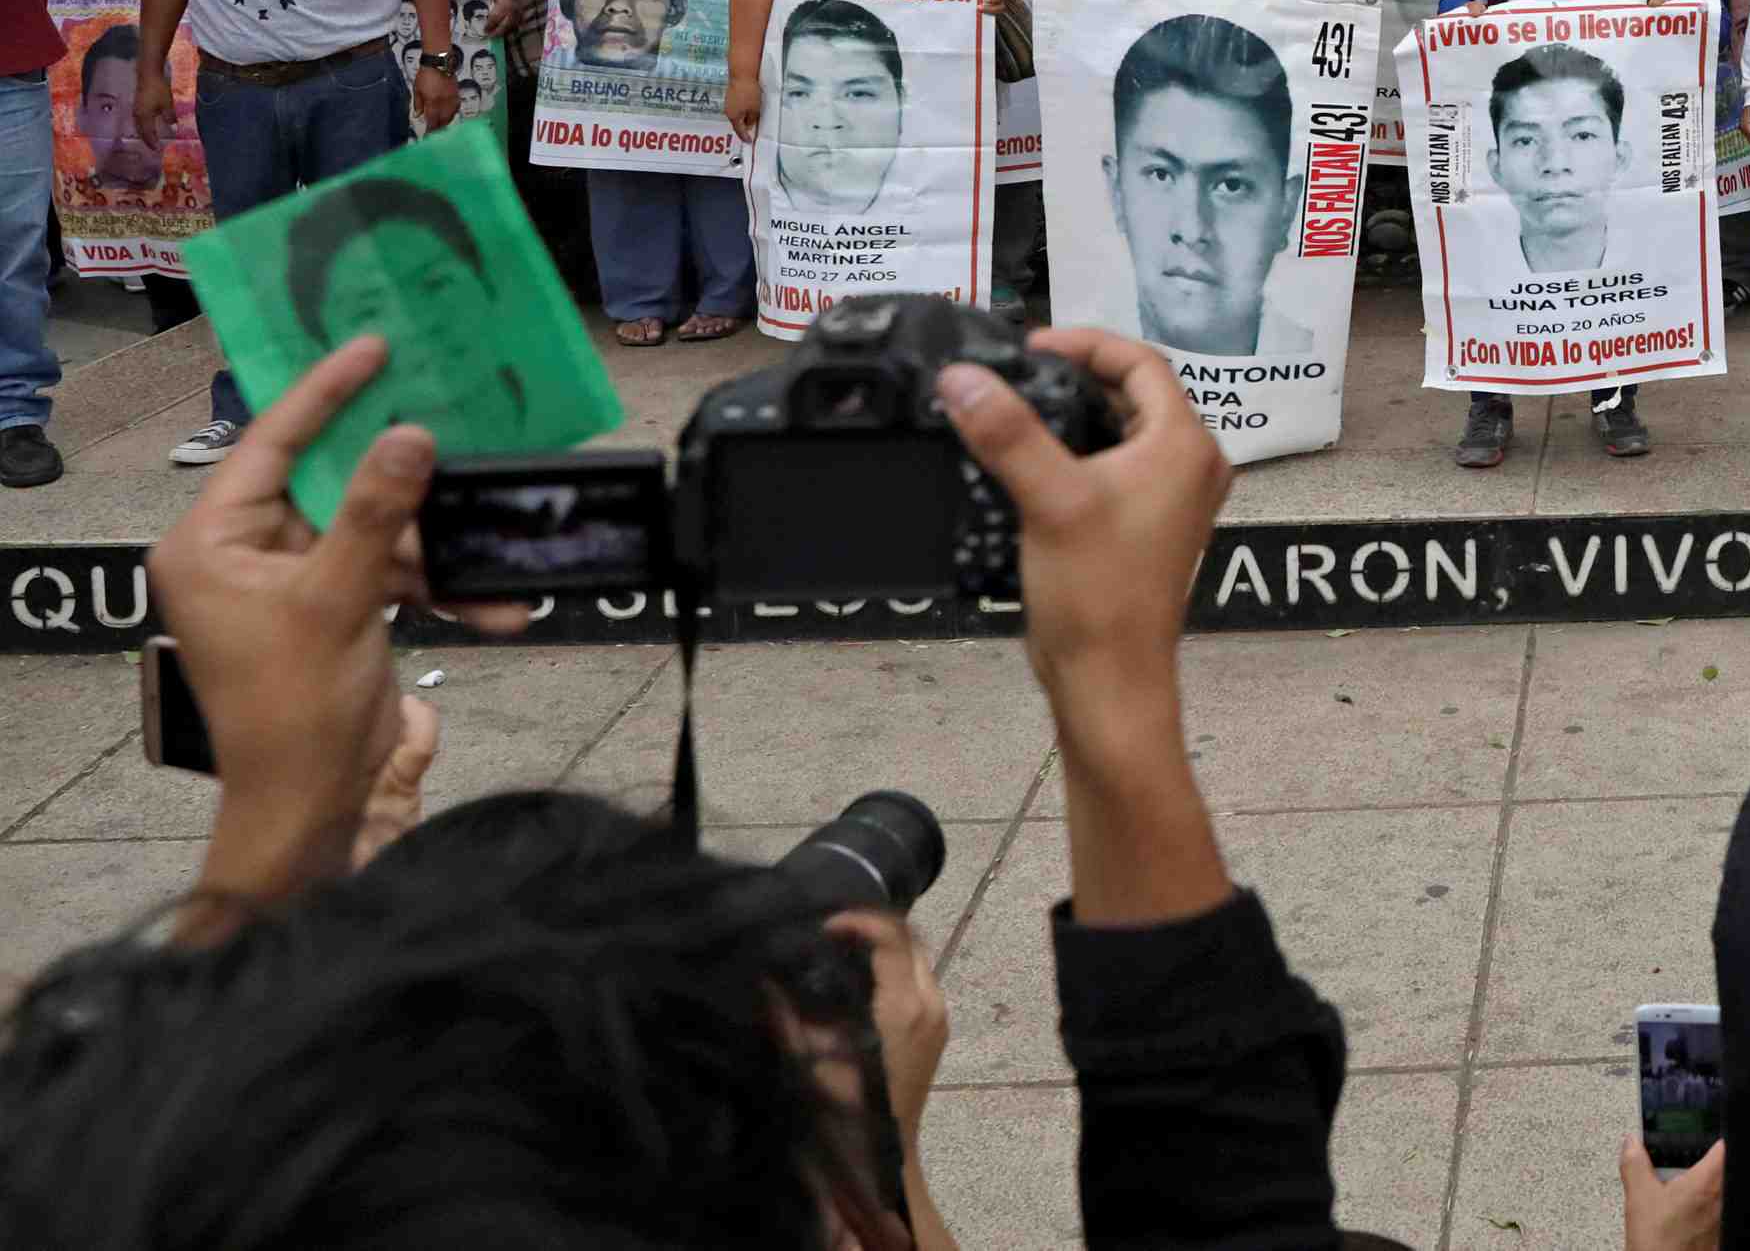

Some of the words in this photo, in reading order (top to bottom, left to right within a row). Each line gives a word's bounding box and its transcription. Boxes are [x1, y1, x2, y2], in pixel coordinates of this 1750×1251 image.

[1429, 20, 1499, 52] ¡Vivo
[1507, 22, 1538, 44] se
[1545, 13, 1571, 41] lo
[1578, 9, 1697, 41] llevaron!
[1311, 21, 1355, 79] 43!
[571, 79, 630, 98] BRUNO
[1669, 92, 1689, 124] 43
[535, 118, 585, 146] VIDA
[591, 122, 612, 147] lo
[618, 128, 733, 156] queremos!
[1310, 103, 1368, 143] 43!
[1429, 133, 1450, 178] FALTAN
[1661, 124, 1681, 168] FALTAN
[1306, 142, 1363, 218] FALTAN
[1431, 181, 1450, 204] NOS
[1662, 169, 1681, 194] NOS
[770, 219, 829, 236] MIGUEL
[1302, 217, 1352, 258] NOS
[82, 245, 134, 261] VIDA
[778, 235, 897, 250] HERNÁNDEZ
[787, 250, 885, 265] MARTÍNEZ
[780, 266, 817, 280] EDAD
[820, 271, 840, 282] 27
[845, 268, 898, 282] AÑOS
[1510, 278, 1580, 296] JOSÉ
[1587, 272, 1644, 290] LUIS
[774, 284, 814, 313] VIDA
[1488, 297, 1556, 312] LUNA
[1563, 285, 1669, 309] TORRES
[1516, 321, 1566, 335] EDAD
[1571, 319, 1593, 331] 20
[1598, 311, 1647, 328] AÑOS
[1460, 337, 1501, 367] ¡Con
[1504, 339, 1558, 367] VIDA
[1563, 336, 1582, 365] lo
[1588, 322, 1695, 365] queremos!
[1180, 362, 1326, 385] ANTONIO
[1216, 538, 1509, 610] ARON,
